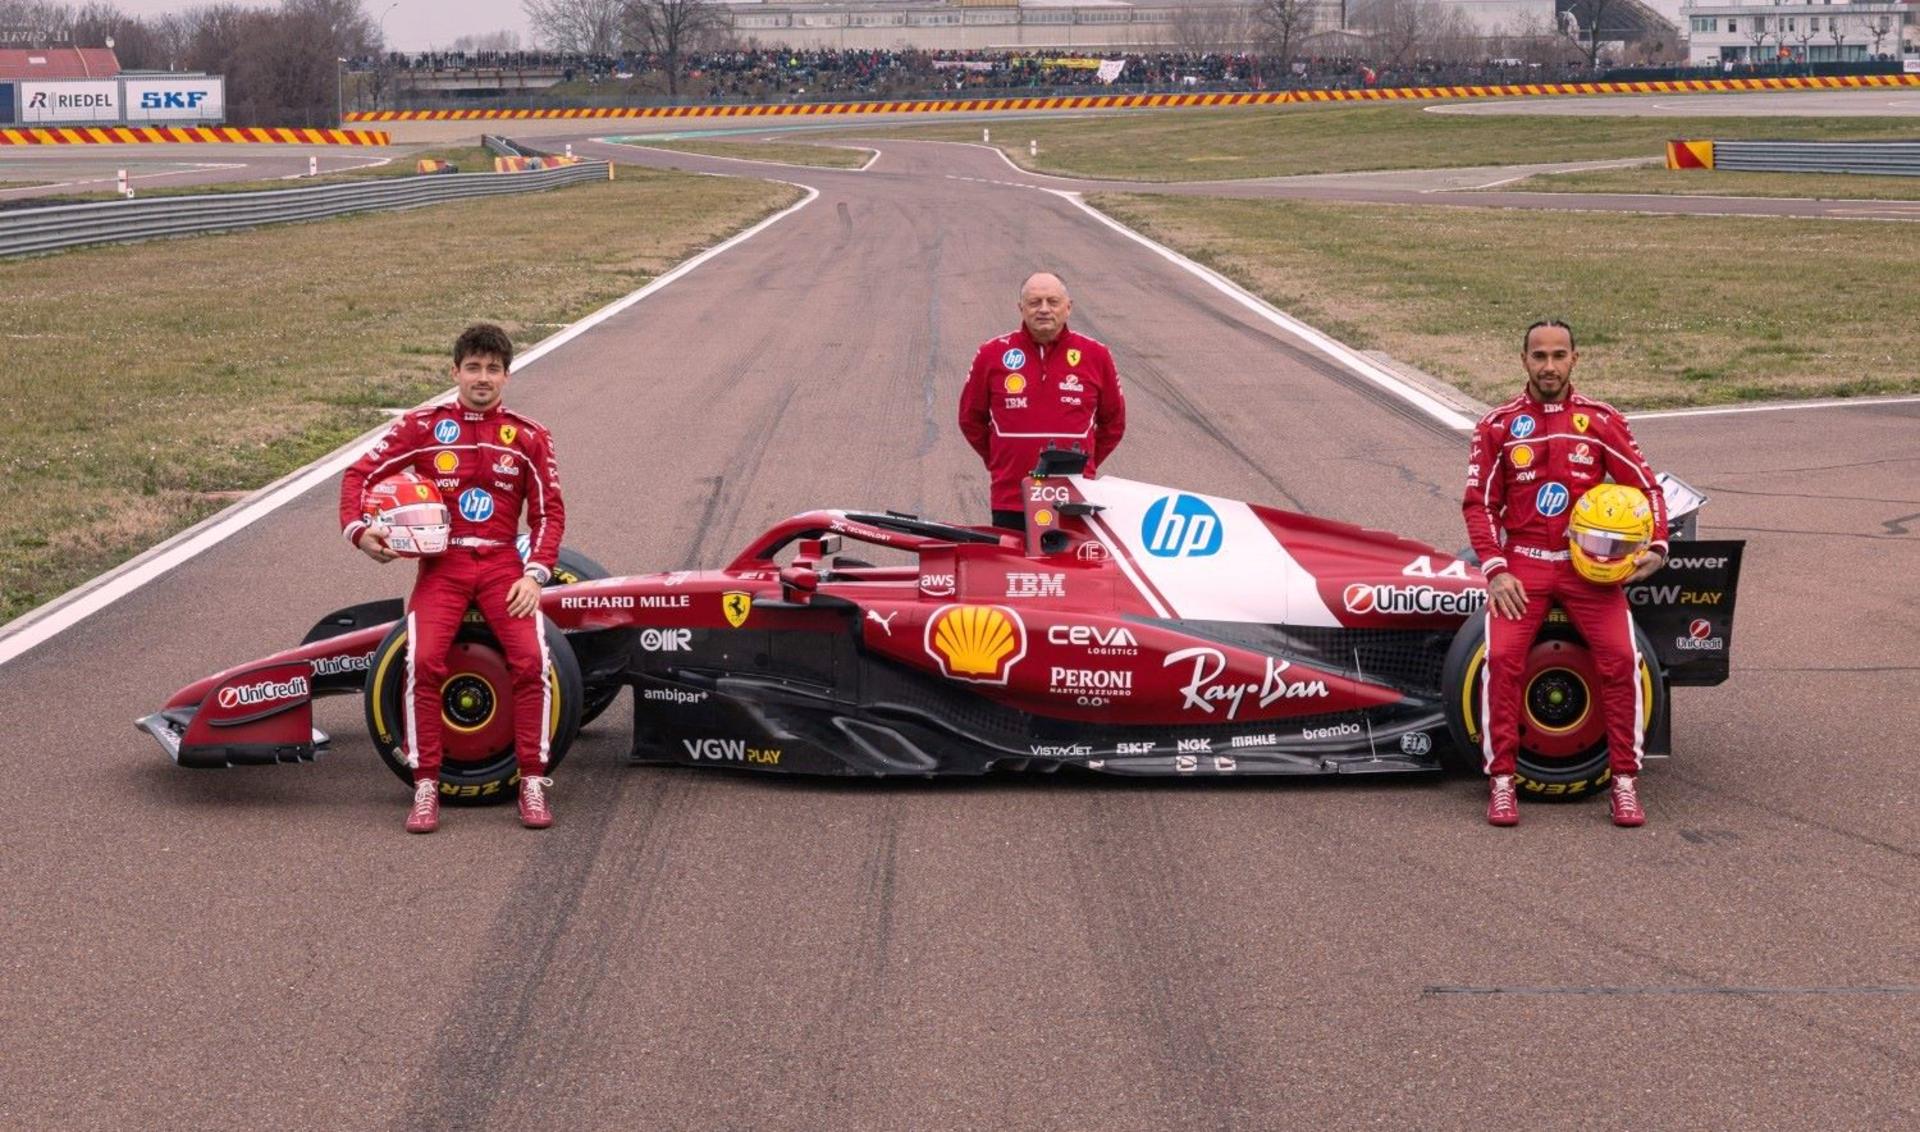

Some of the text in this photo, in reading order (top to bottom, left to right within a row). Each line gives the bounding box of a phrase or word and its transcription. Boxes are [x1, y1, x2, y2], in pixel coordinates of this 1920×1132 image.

[58, 94, 112, 108] RIEDEL
[141, 91, 207, 109] SKF
[436, 419, 458, 444] hp
[1030, 486, 1069, 501] ZCG
[1538, 482, 1567, 516] hp
[461, 488, 492, 522] hp
[1143, 494, 1222, 557] hp
[1402, 555, 1471, 580] 44
[1667, 557, 1728, 569] ower
[921, 574, 955, 586] aws
[1006, 572, 1066, 597] IBM
[561, 595, 690, 608] RICHARD MILLE
[1374, 586, 1488, 614] UniCredit
[1681, 592, 1722, 604] PLAY
[1087, 647, 1138, 655] LOGISTICS
[316, 652, 376, 675] UniCred
[1050, 667, 1132, 688] PERONI
[238, 679, 307, 703] UniCredit
[1088, 688, 1131, 696] AZZURRO
[1302, 723, 1360, 740] brembo
[1116, 742, 1156, 754] SKF
[1177, 738, 1212, 751] NGK
[1231, 734, 1277, 747] MAHLE
[684, 739, 781, 764] VGW PLAY
[440, 780, 500, 797] ZER
